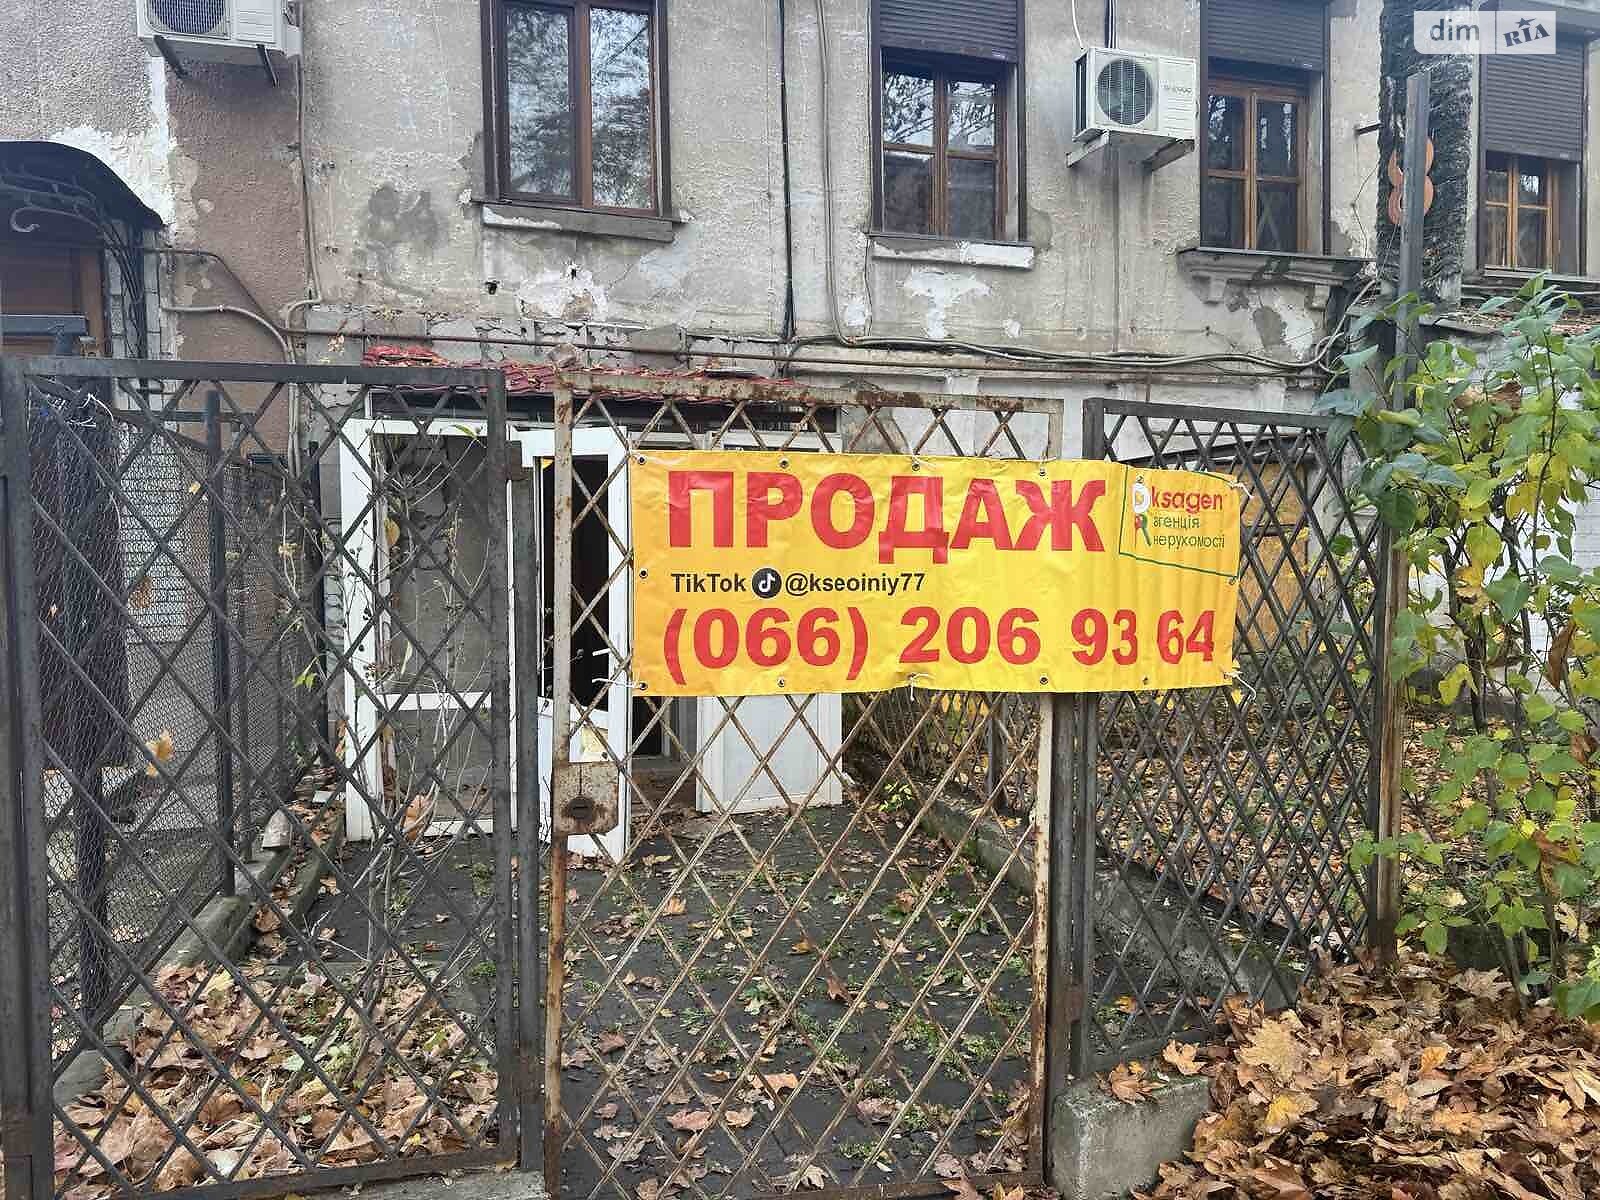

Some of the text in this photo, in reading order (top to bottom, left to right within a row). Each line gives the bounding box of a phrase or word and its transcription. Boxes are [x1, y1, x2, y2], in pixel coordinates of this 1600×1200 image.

[668, 470, 1106, 565] ПРОДАЖ
[1153, 514, 1200, 531] агенція
[1153, 534, 1225, 550] нерухомості
[671, 572, 925, 597] TikTok @kseoiniy77
[663, 606, 1215, 686] (066) 206 93 64
